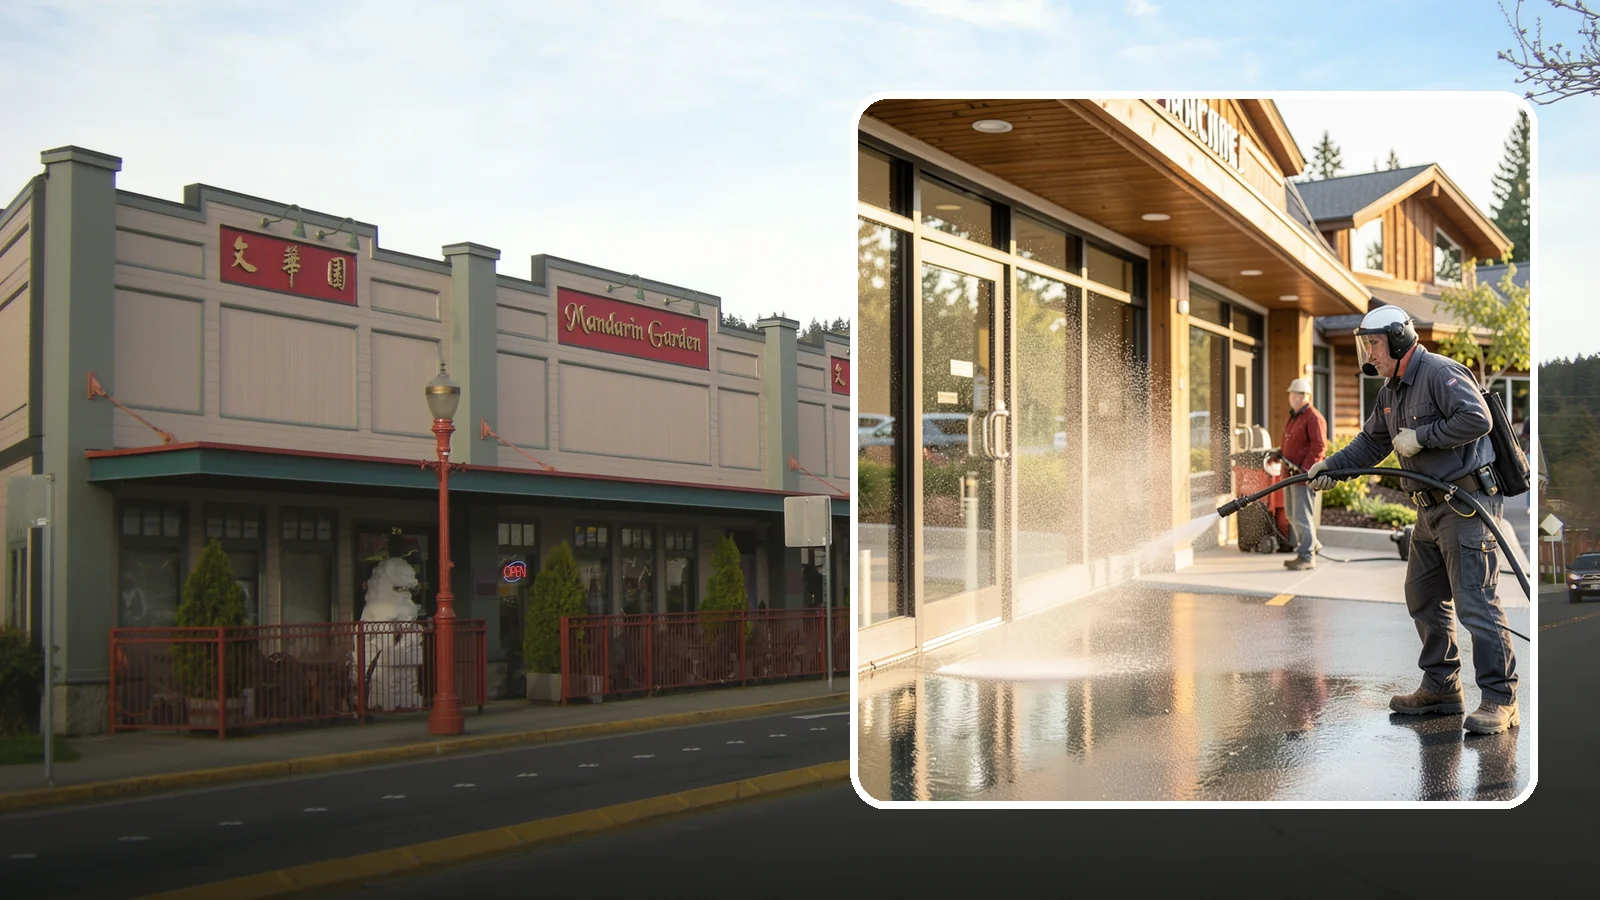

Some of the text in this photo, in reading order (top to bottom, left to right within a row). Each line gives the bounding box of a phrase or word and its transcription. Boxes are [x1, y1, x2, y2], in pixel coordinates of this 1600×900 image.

[230, 235, 346, 291] 文華園
[564, 302, 701, 352] Mandarin Garden
[503, 565, 527, 578] OPEN
